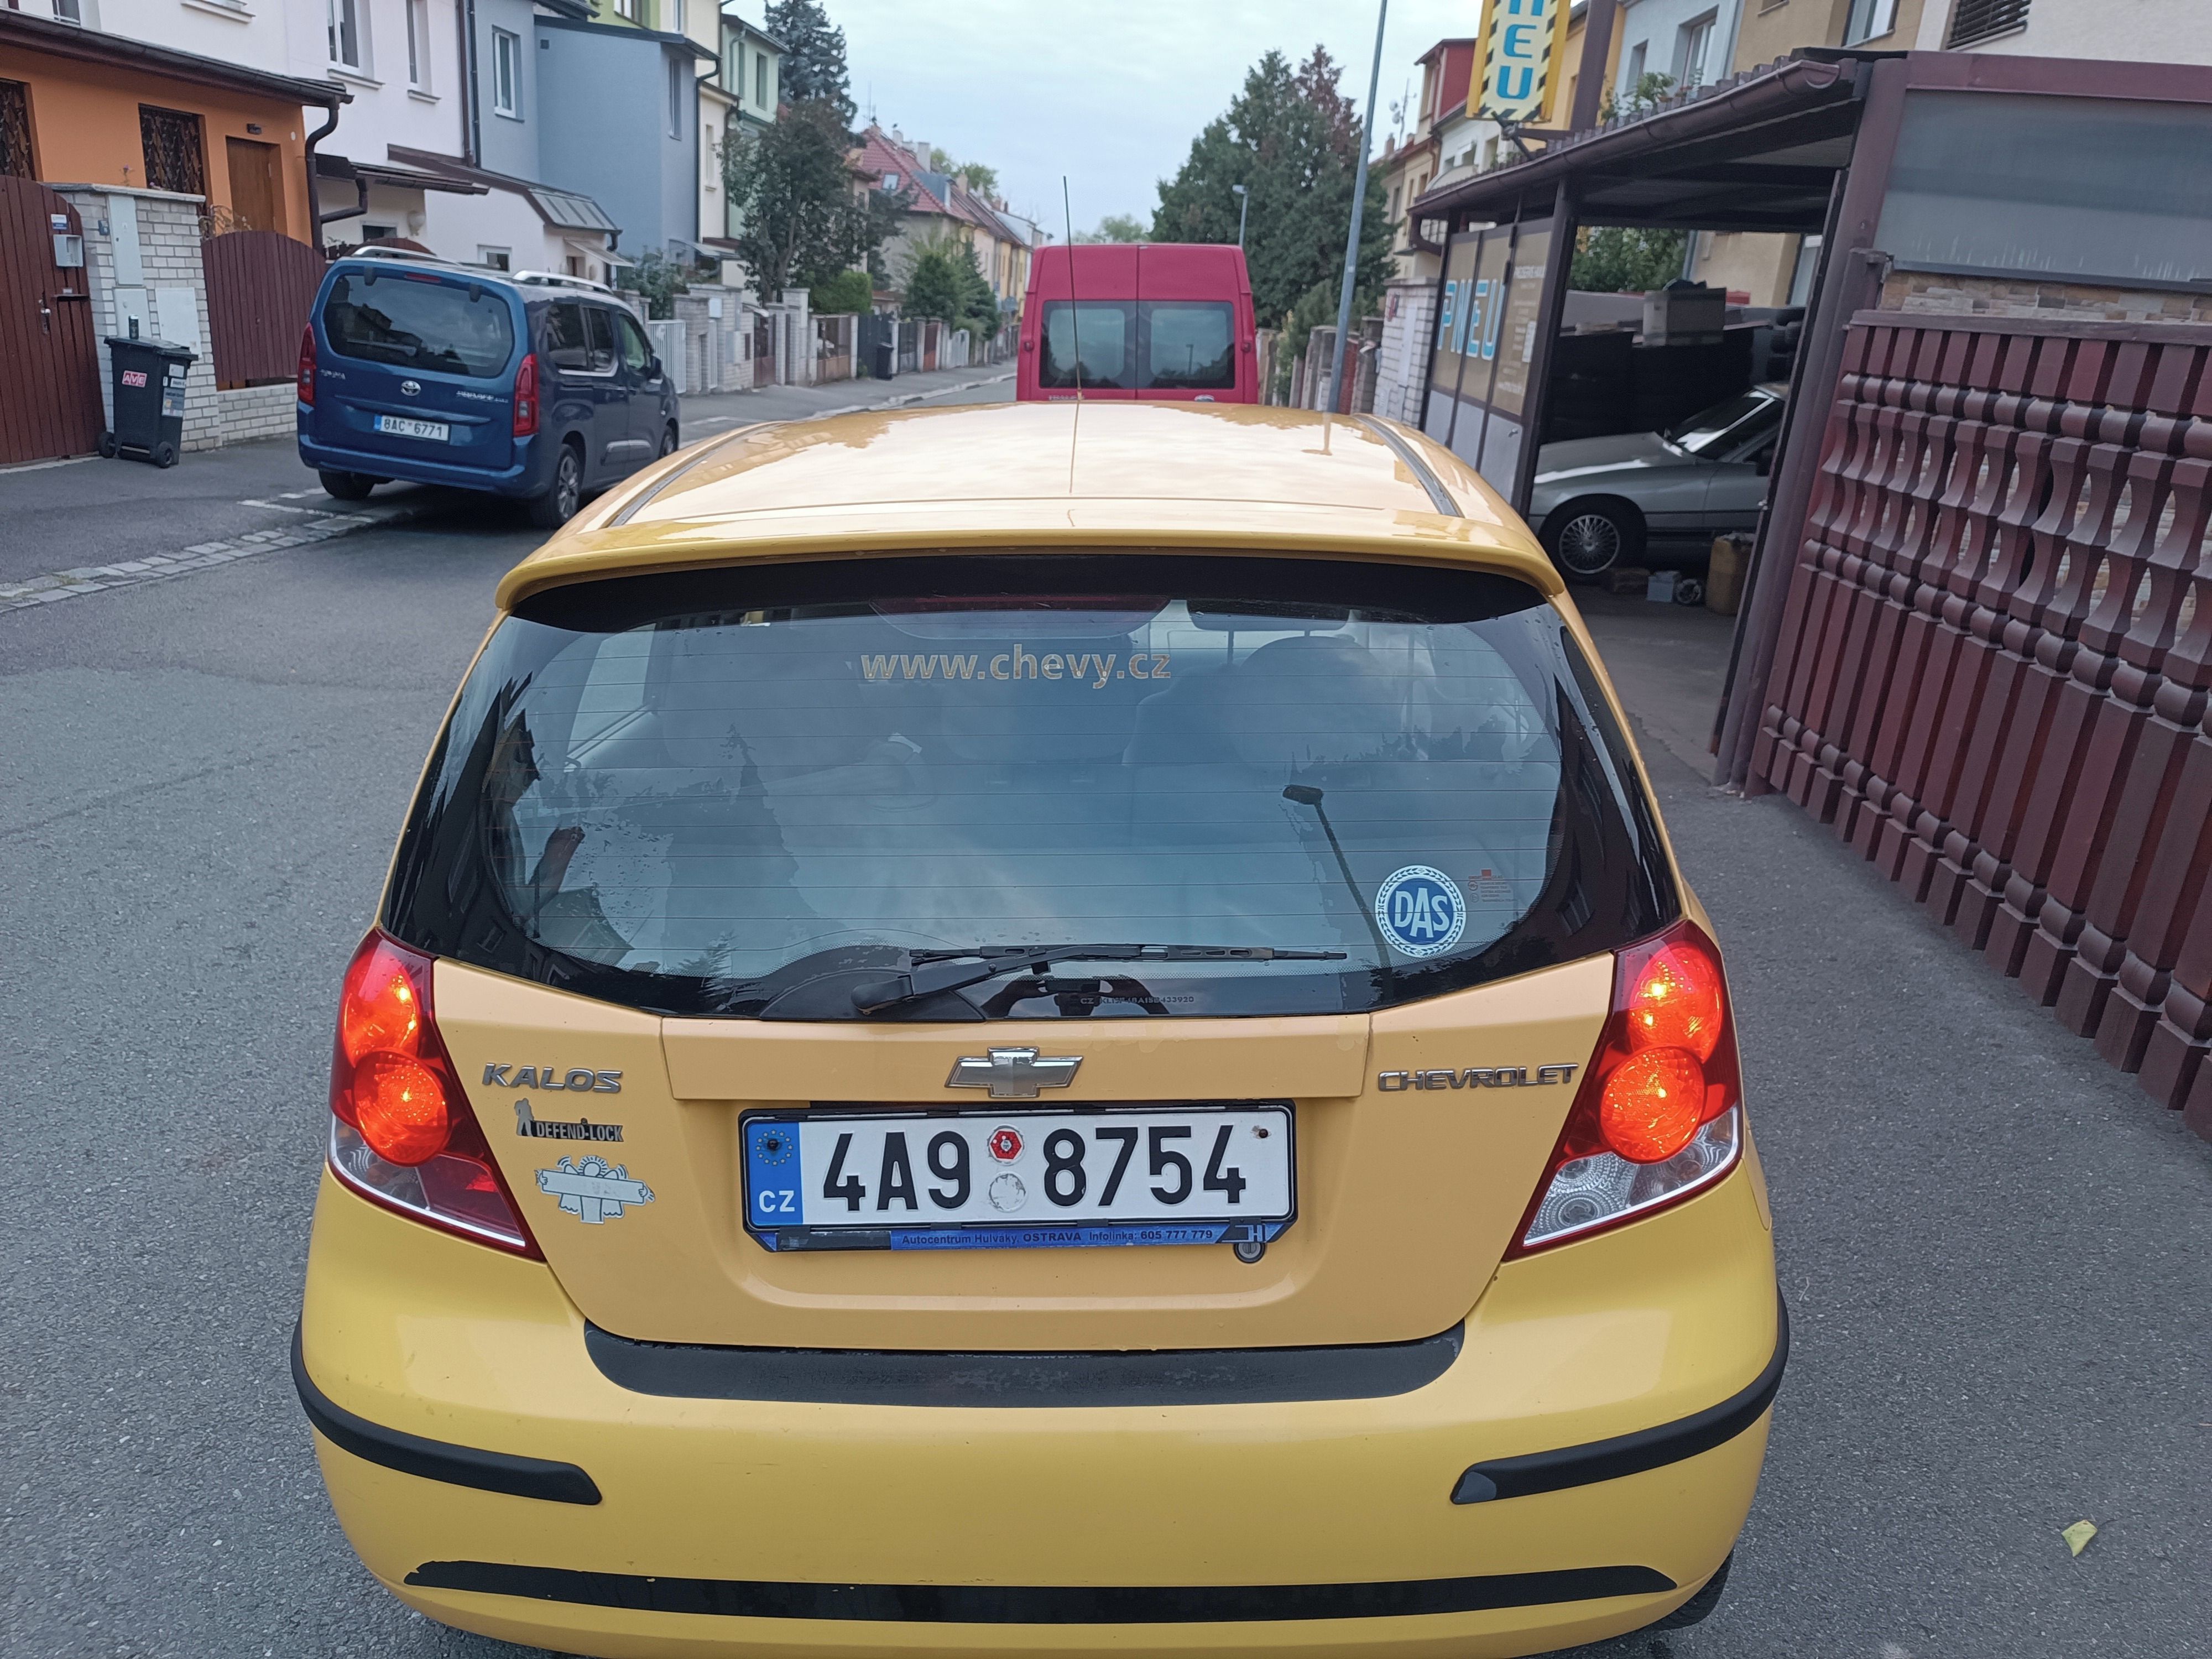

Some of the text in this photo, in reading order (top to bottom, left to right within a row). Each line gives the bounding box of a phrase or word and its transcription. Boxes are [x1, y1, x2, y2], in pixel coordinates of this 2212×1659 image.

[1437, 278, 1506, 361] PNEU
[123, 373, 146, 386] AVE
[384, 419, 442, 437] 8AC 6771
[860, 644, 1171, 689] www.chevy.cz
[1394, 888, 1450, 938] DAS
[482, 1063, 623, 1094] KALOS
[1378, 1063, 1579, 1092] CHEVROLET
[536, 1121, 624, 1141] DEFEND-LOCK
[823, 1124, 1246, 1211] 4A9 8754
[759, 1190, 795, 1213] CZ
[902, 1235, 971, 1244] Autocentrum
[1023, 1232, 1082, 1242] OSTRAVA
[1089, 1231, 1138, 1241] Infolinka:
[1140, 1231, 1161, 1239] 605
[1166, 1230, 1187, 1239] 777
[1191, 1230, 1213, 1239] 779
